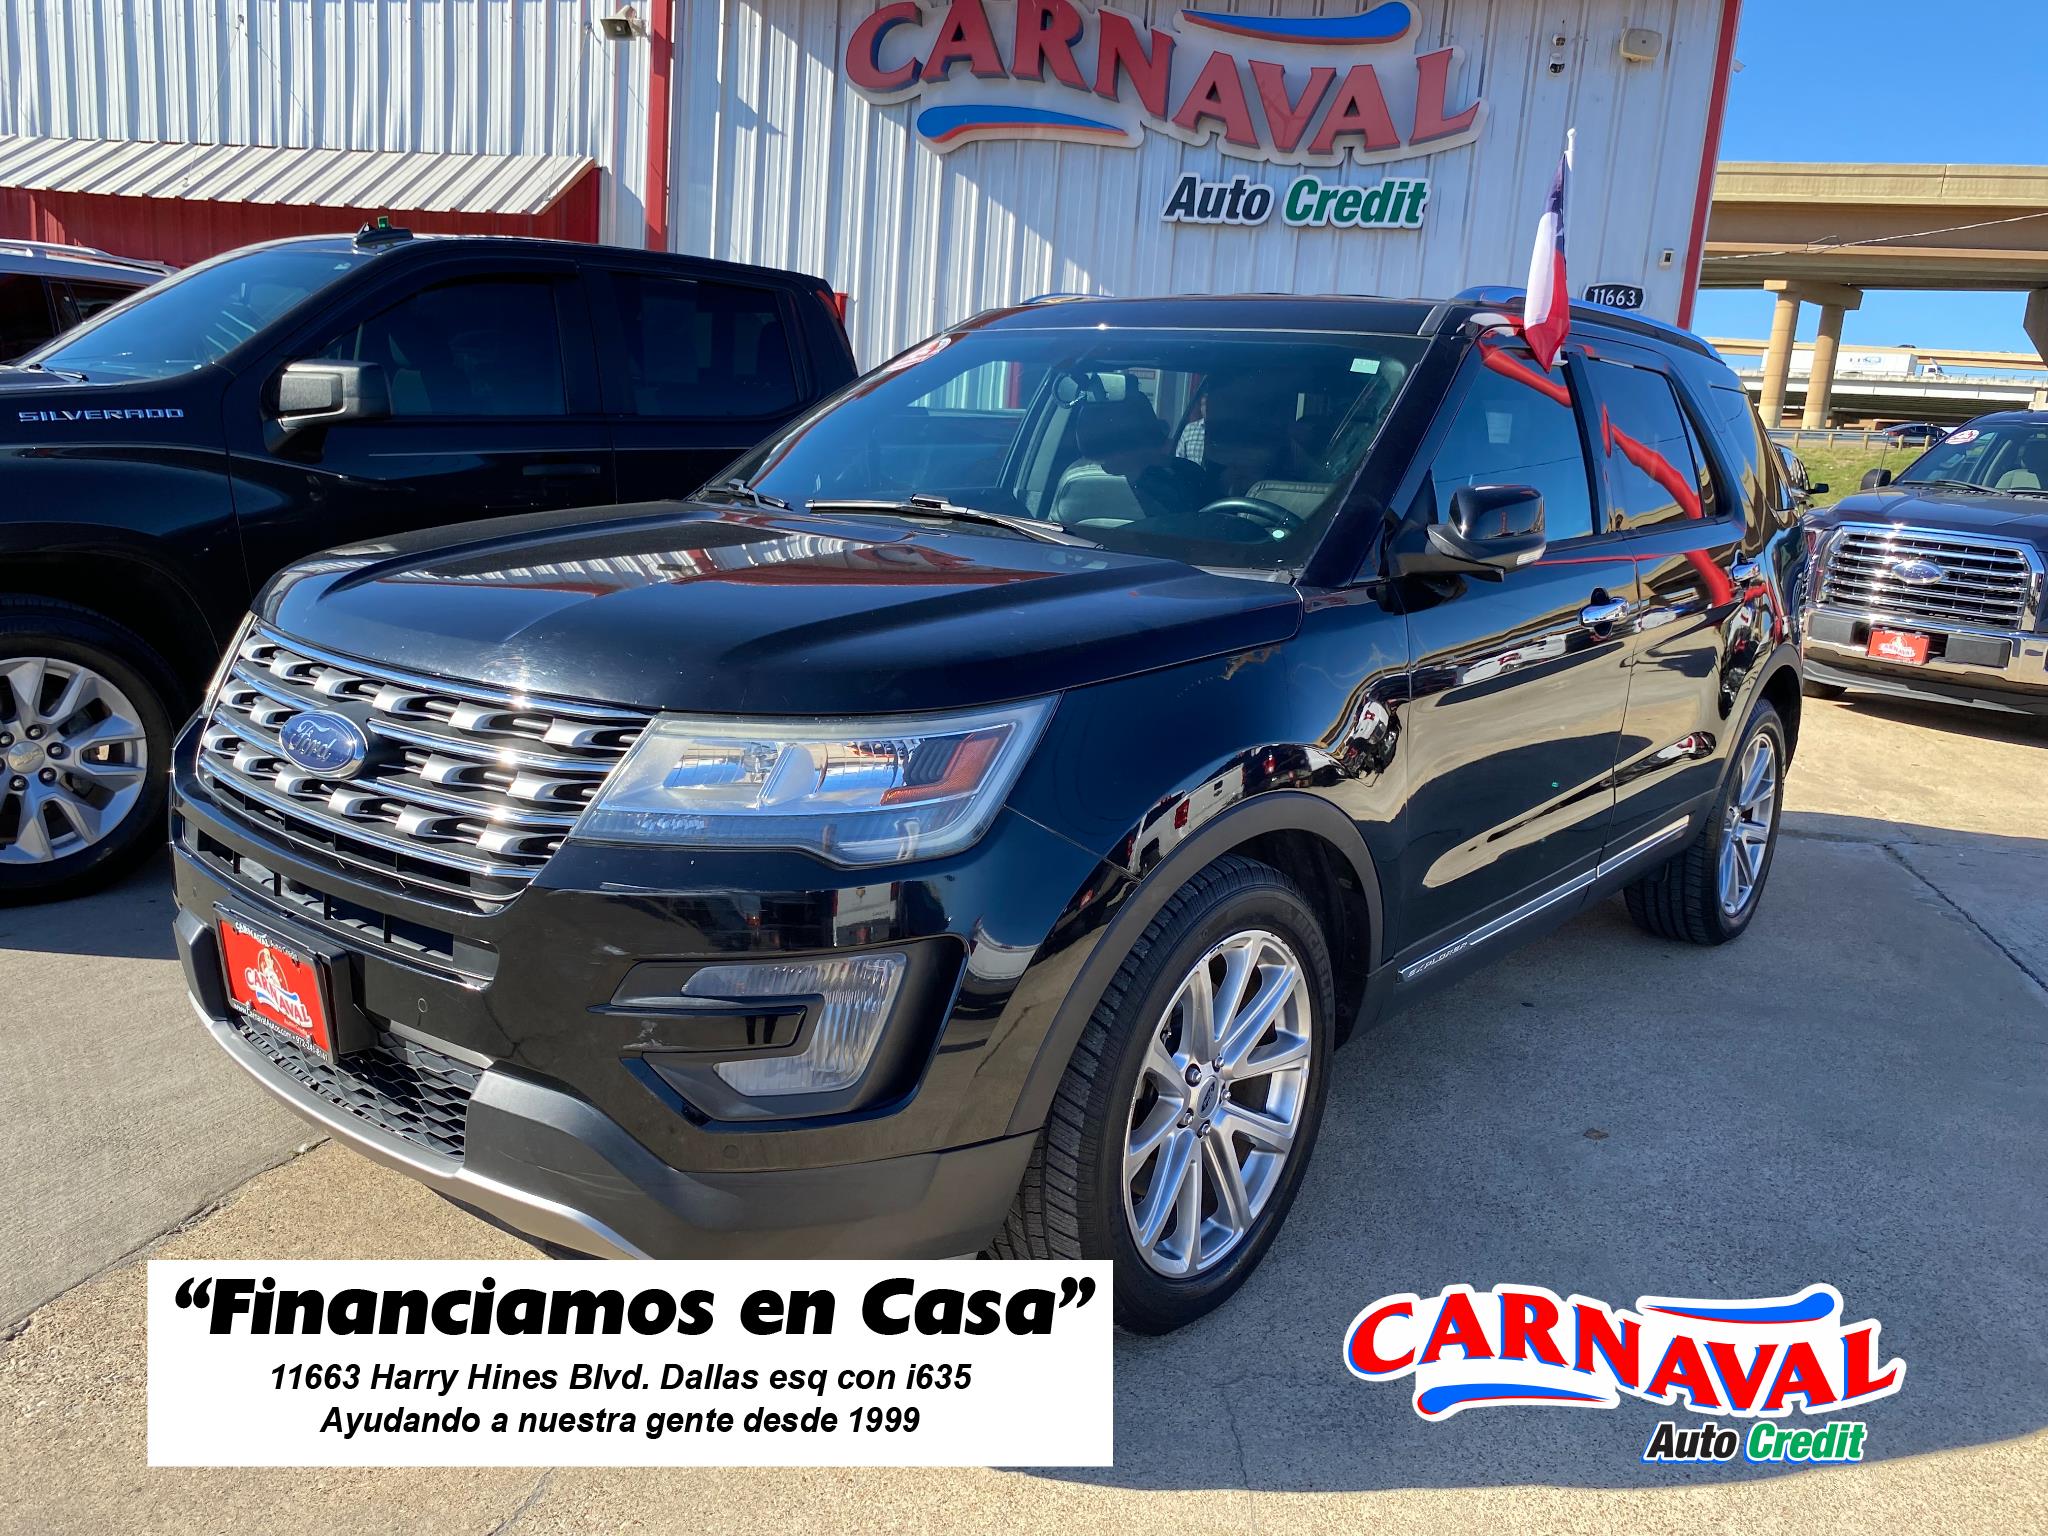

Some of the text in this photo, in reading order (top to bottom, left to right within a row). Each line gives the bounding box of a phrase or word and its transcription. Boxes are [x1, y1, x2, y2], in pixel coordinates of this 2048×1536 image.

[845, 0, 1480, 155] CARNAVAL
[1164, 176, 1427, 224] Auto Credit
[1593, 288, 1636, 306] 11663
[18, 408, 184, 422] SILVERADO
[289, 719, 338, 762] Ford
[246, 968, 311, 1024] CARNAVAL
